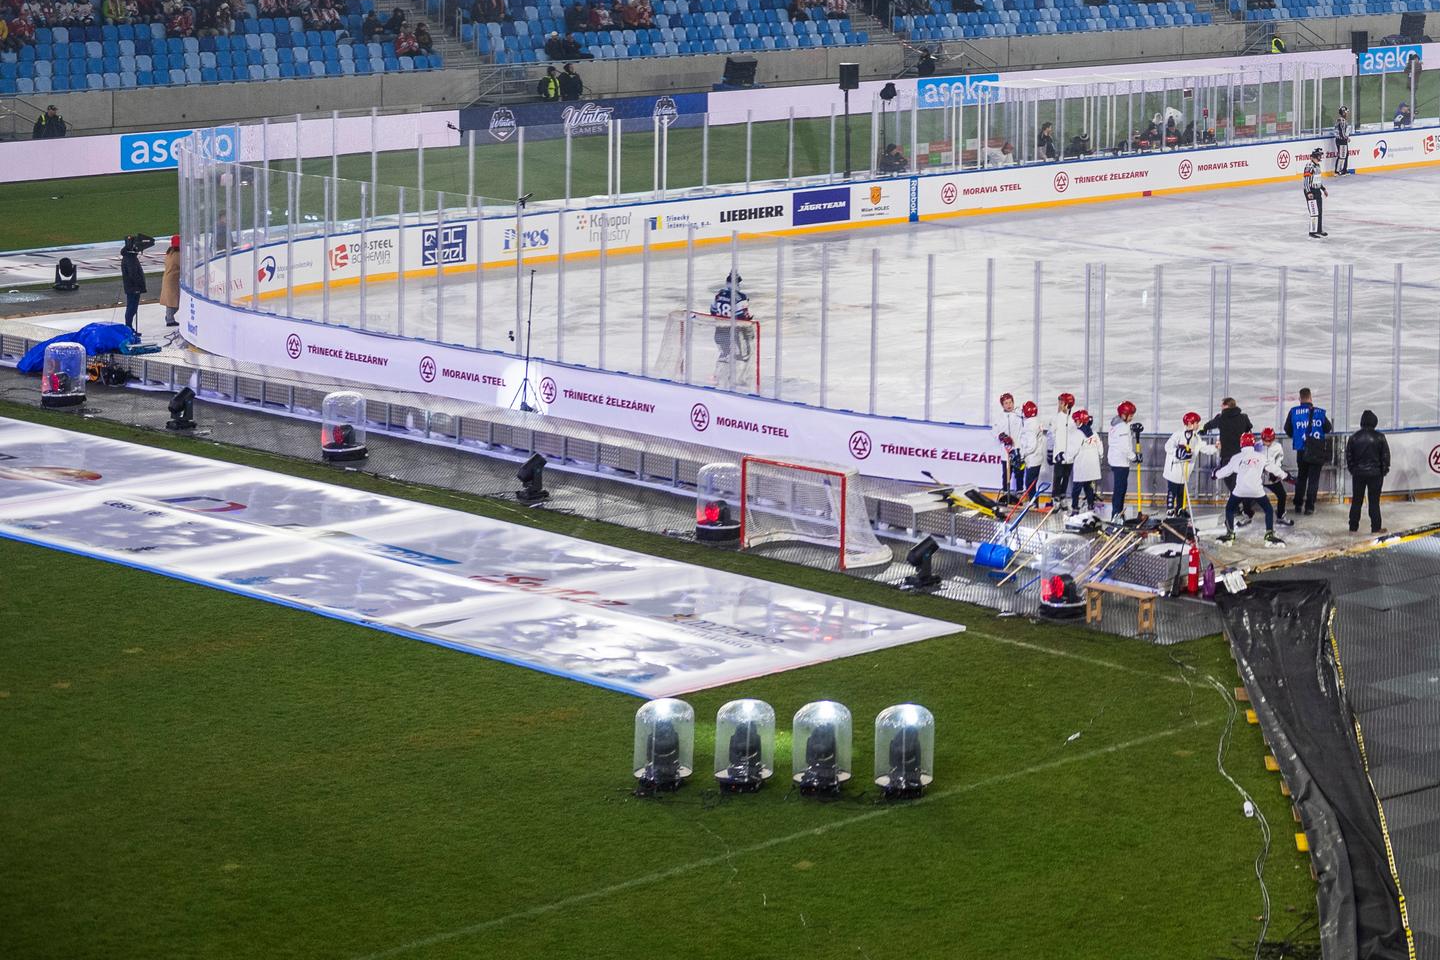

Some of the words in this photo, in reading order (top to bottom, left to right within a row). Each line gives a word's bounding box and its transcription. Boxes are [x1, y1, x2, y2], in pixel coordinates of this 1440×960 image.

[1197, 162, 1229, 172] MORAVIA
[1229, 160, 1249, 169] STEEL
[1074, 173, 1109, 184] TŘINECKÉ
[1109, 170, 1149, 182] ŽELEZÁRNY
[910, 179, 918, 215] Reebok
[962, 185, 998, 196] MORAVIA
[999, 183, 1022, 193] STEEL
[719, 204, 784, 224] LIEBHERR
[798, 200, 847, 213] JÄGRTEAM
[589, 228, 631, 242] Inustry
[307, 344, 343, 359] TŘINECKÉ
[345, 350, 389, 367] ŽELEZÁRNY
[442, 367, 480, 383] MORAVIA
[482, 375, 507, 388] STEEL
[563, 388, 603, 405] TŘINECKÉ
[606, 395, 656, 414] ŽELEZÁRNY
[716, 415, 759, 433] MORAVIA
[761, 424, 789, 439] STEEL
[880, 443, 938, 459] TŘINECKÉ
